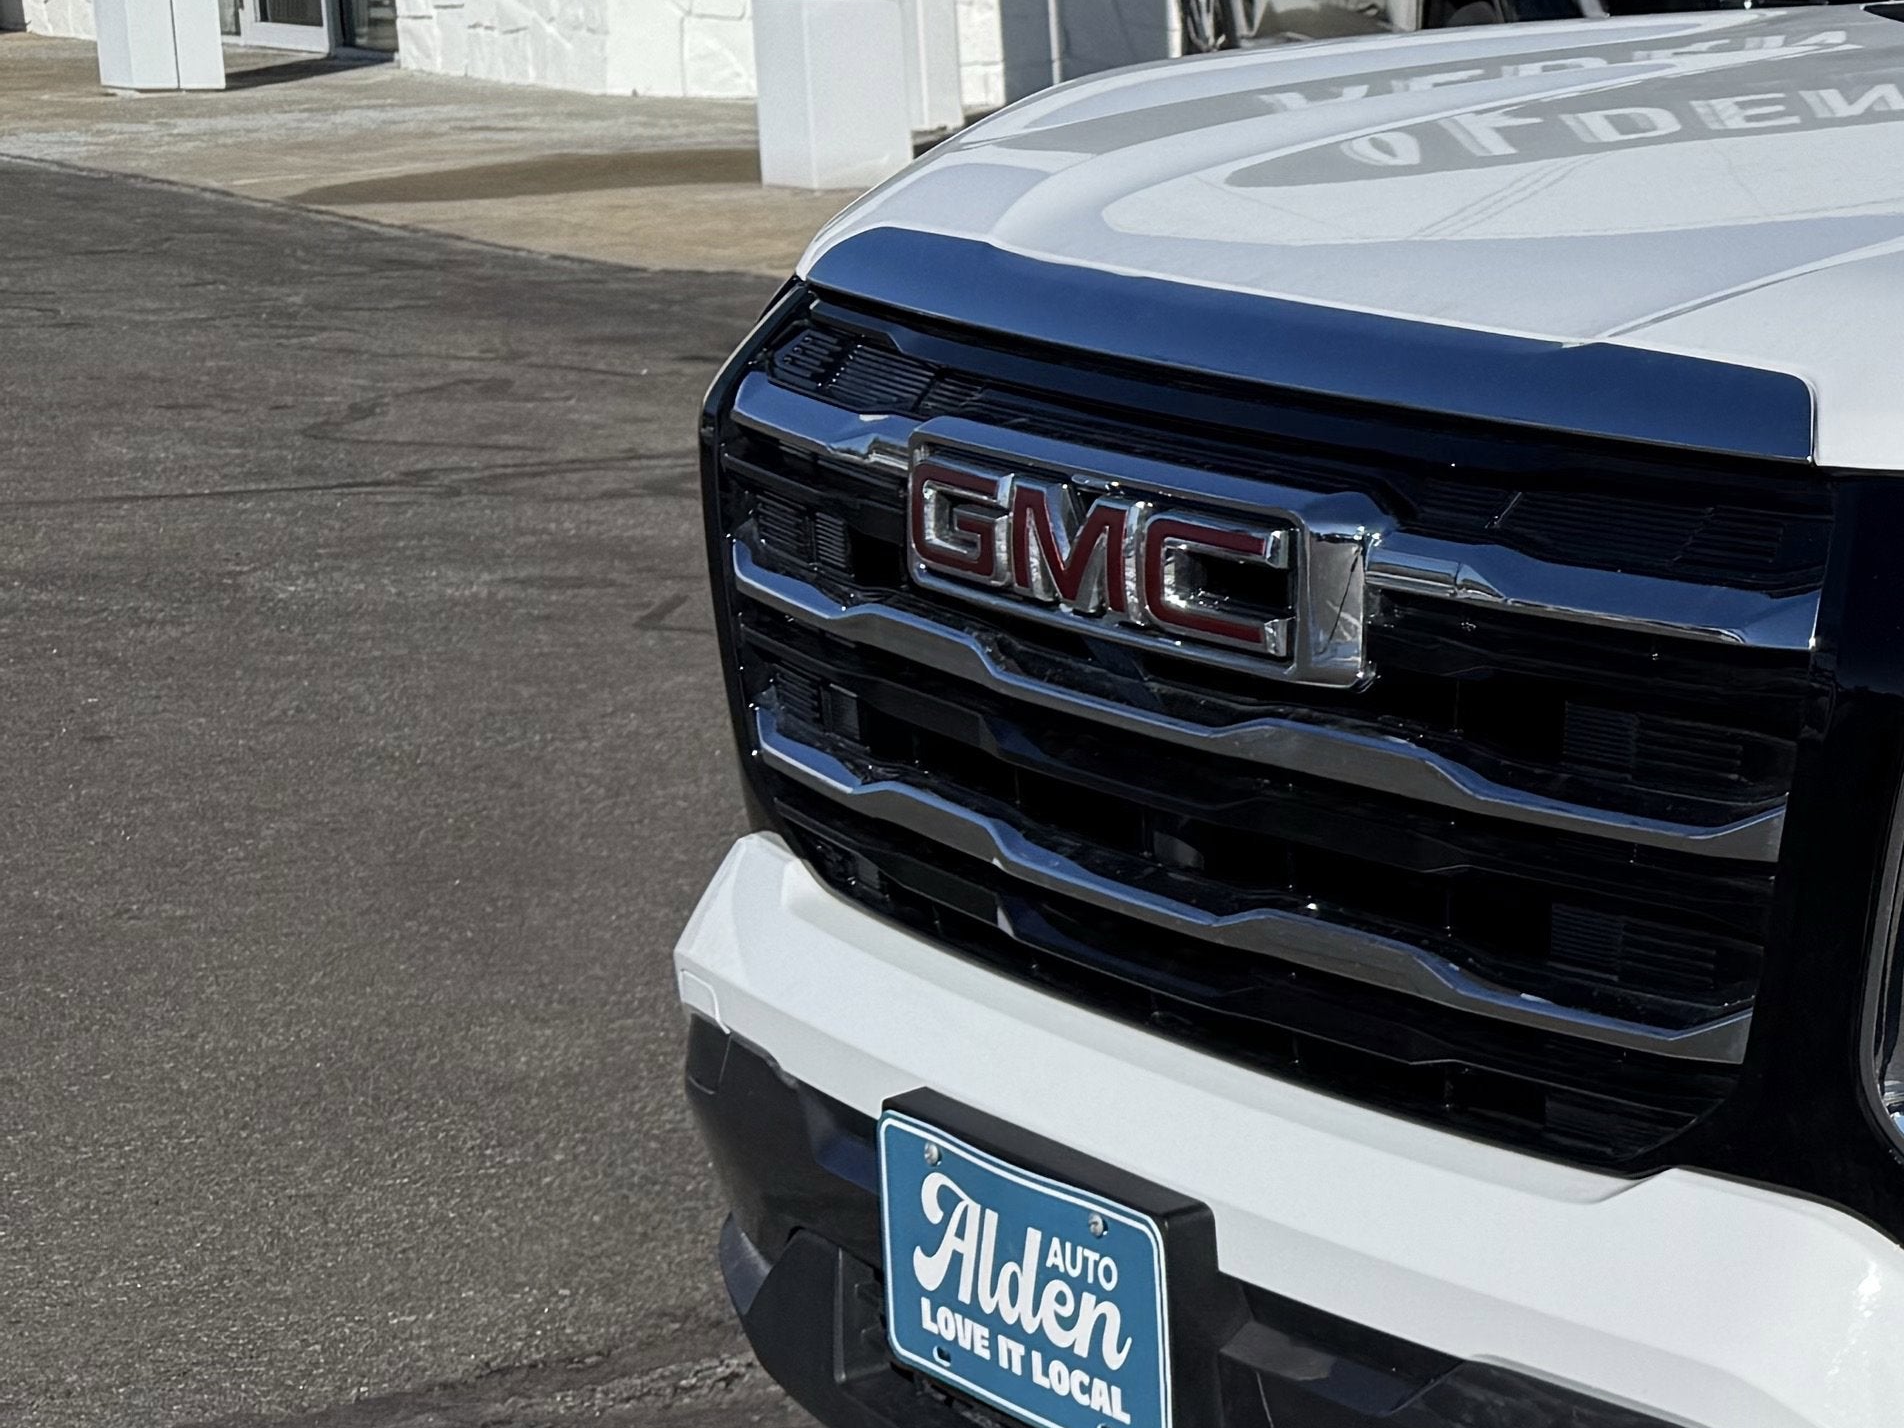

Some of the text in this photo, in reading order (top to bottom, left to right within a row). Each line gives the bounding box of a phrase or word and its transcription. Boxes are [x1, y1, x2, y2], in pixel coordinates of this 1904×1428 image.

[909, 461, 1291, 660] GMC
[912, 1172, 1133, 1370] Alden
[1046, 1236, 1118, 1292] AUTO
[920, 1297, 1132, 1425] LOVE IT LOCAL
